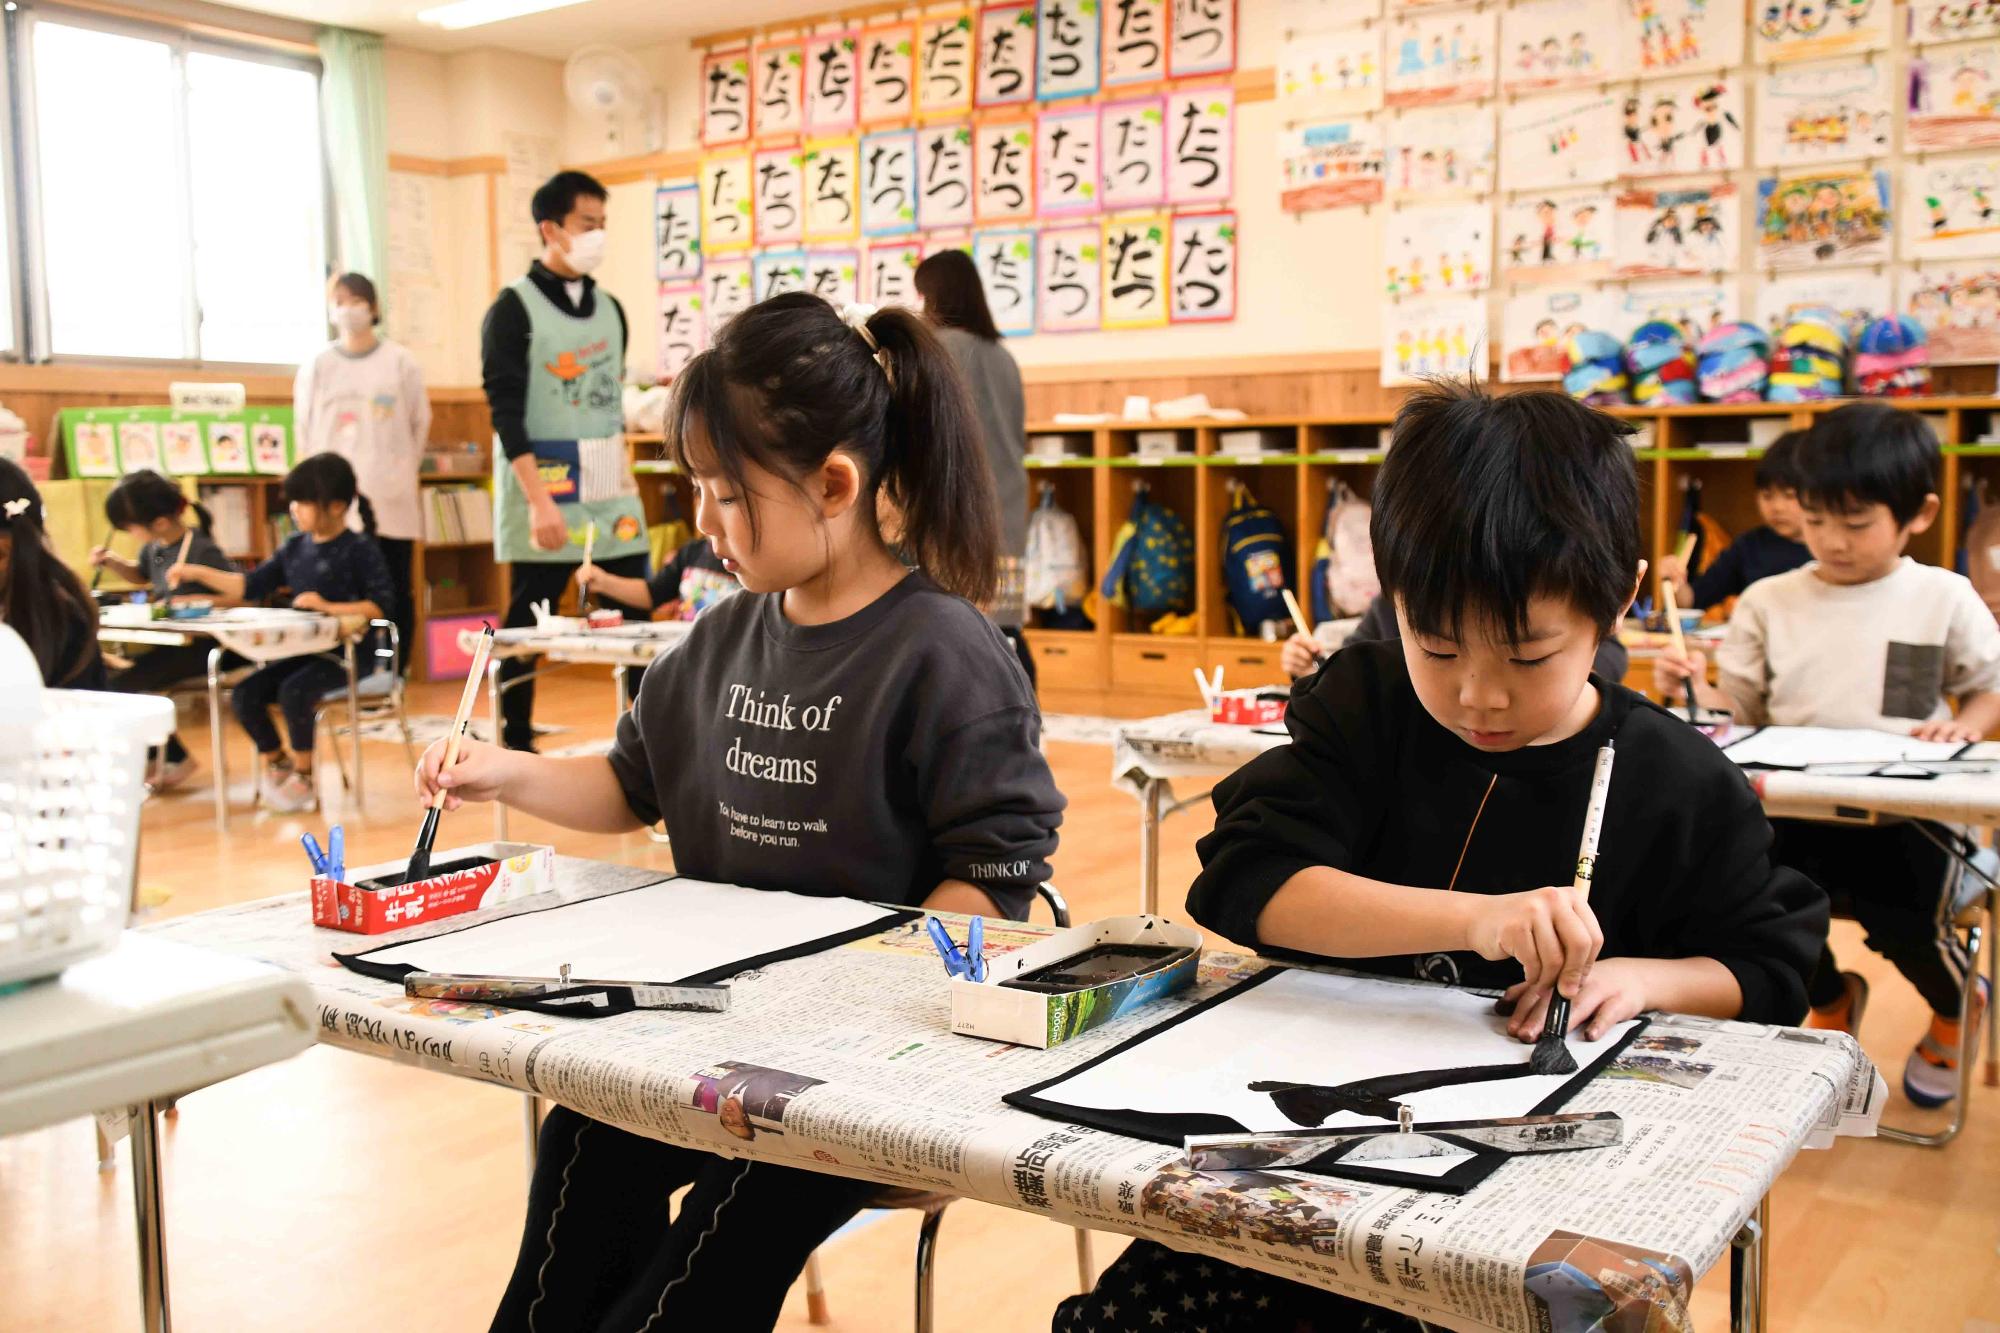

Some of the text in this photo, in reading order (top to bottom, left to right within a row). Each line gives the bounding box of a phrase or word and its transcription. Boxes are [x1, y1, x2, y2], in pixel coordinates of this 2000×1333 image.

[927, 25, 963, 97] たつ
[990, 27, 1022, 95] たつ
[1045, 1, 1082, 76] たつ
[1118, 0, 1159, 68] たつ
[710, 64, 744, 131] たつ
[766, 54, 790, 119] たつ
[818, 42, 849, 111] たつ
[870, 41, 907, 103] たつ
[927, 135, 967, 209] たつ
[991, 136, 1024, 208] たつ
[1052, 125, 1090, 193] たつ
[1117, 118, 1150, 184] たつ
[1178, 102, 1219, 188] たつ
[713, 167, 740, 232] たつ
[760, 160, 796, 229] たつ
[818, 157, 850, 222] たつ
[870, 147, 905, 211] たつ
[661, 202, 688, 268] たつ
[990, 242, 1021, 311] たつ
[1048, 241, 1088, 316] たつ
[1112, 230, 1155, 309] たつ
[1178, 230, 1226, 308] たつ
[664, 304, 694, 362] たつ
[725, 684, 842, 731] Think of
[726, 737, 817, 785] dreams
[730, 823, 758, 842] before
[760, 834, 778, 846] you
[731, 806, 749, 824] have
[750, 815, 760, 826] to
[762, 814, 786, 830] learn
[788, 820, 801, 831] to
[803, 819, 828, 832] walk
[968, 859, 1030, 879] THINK OF
